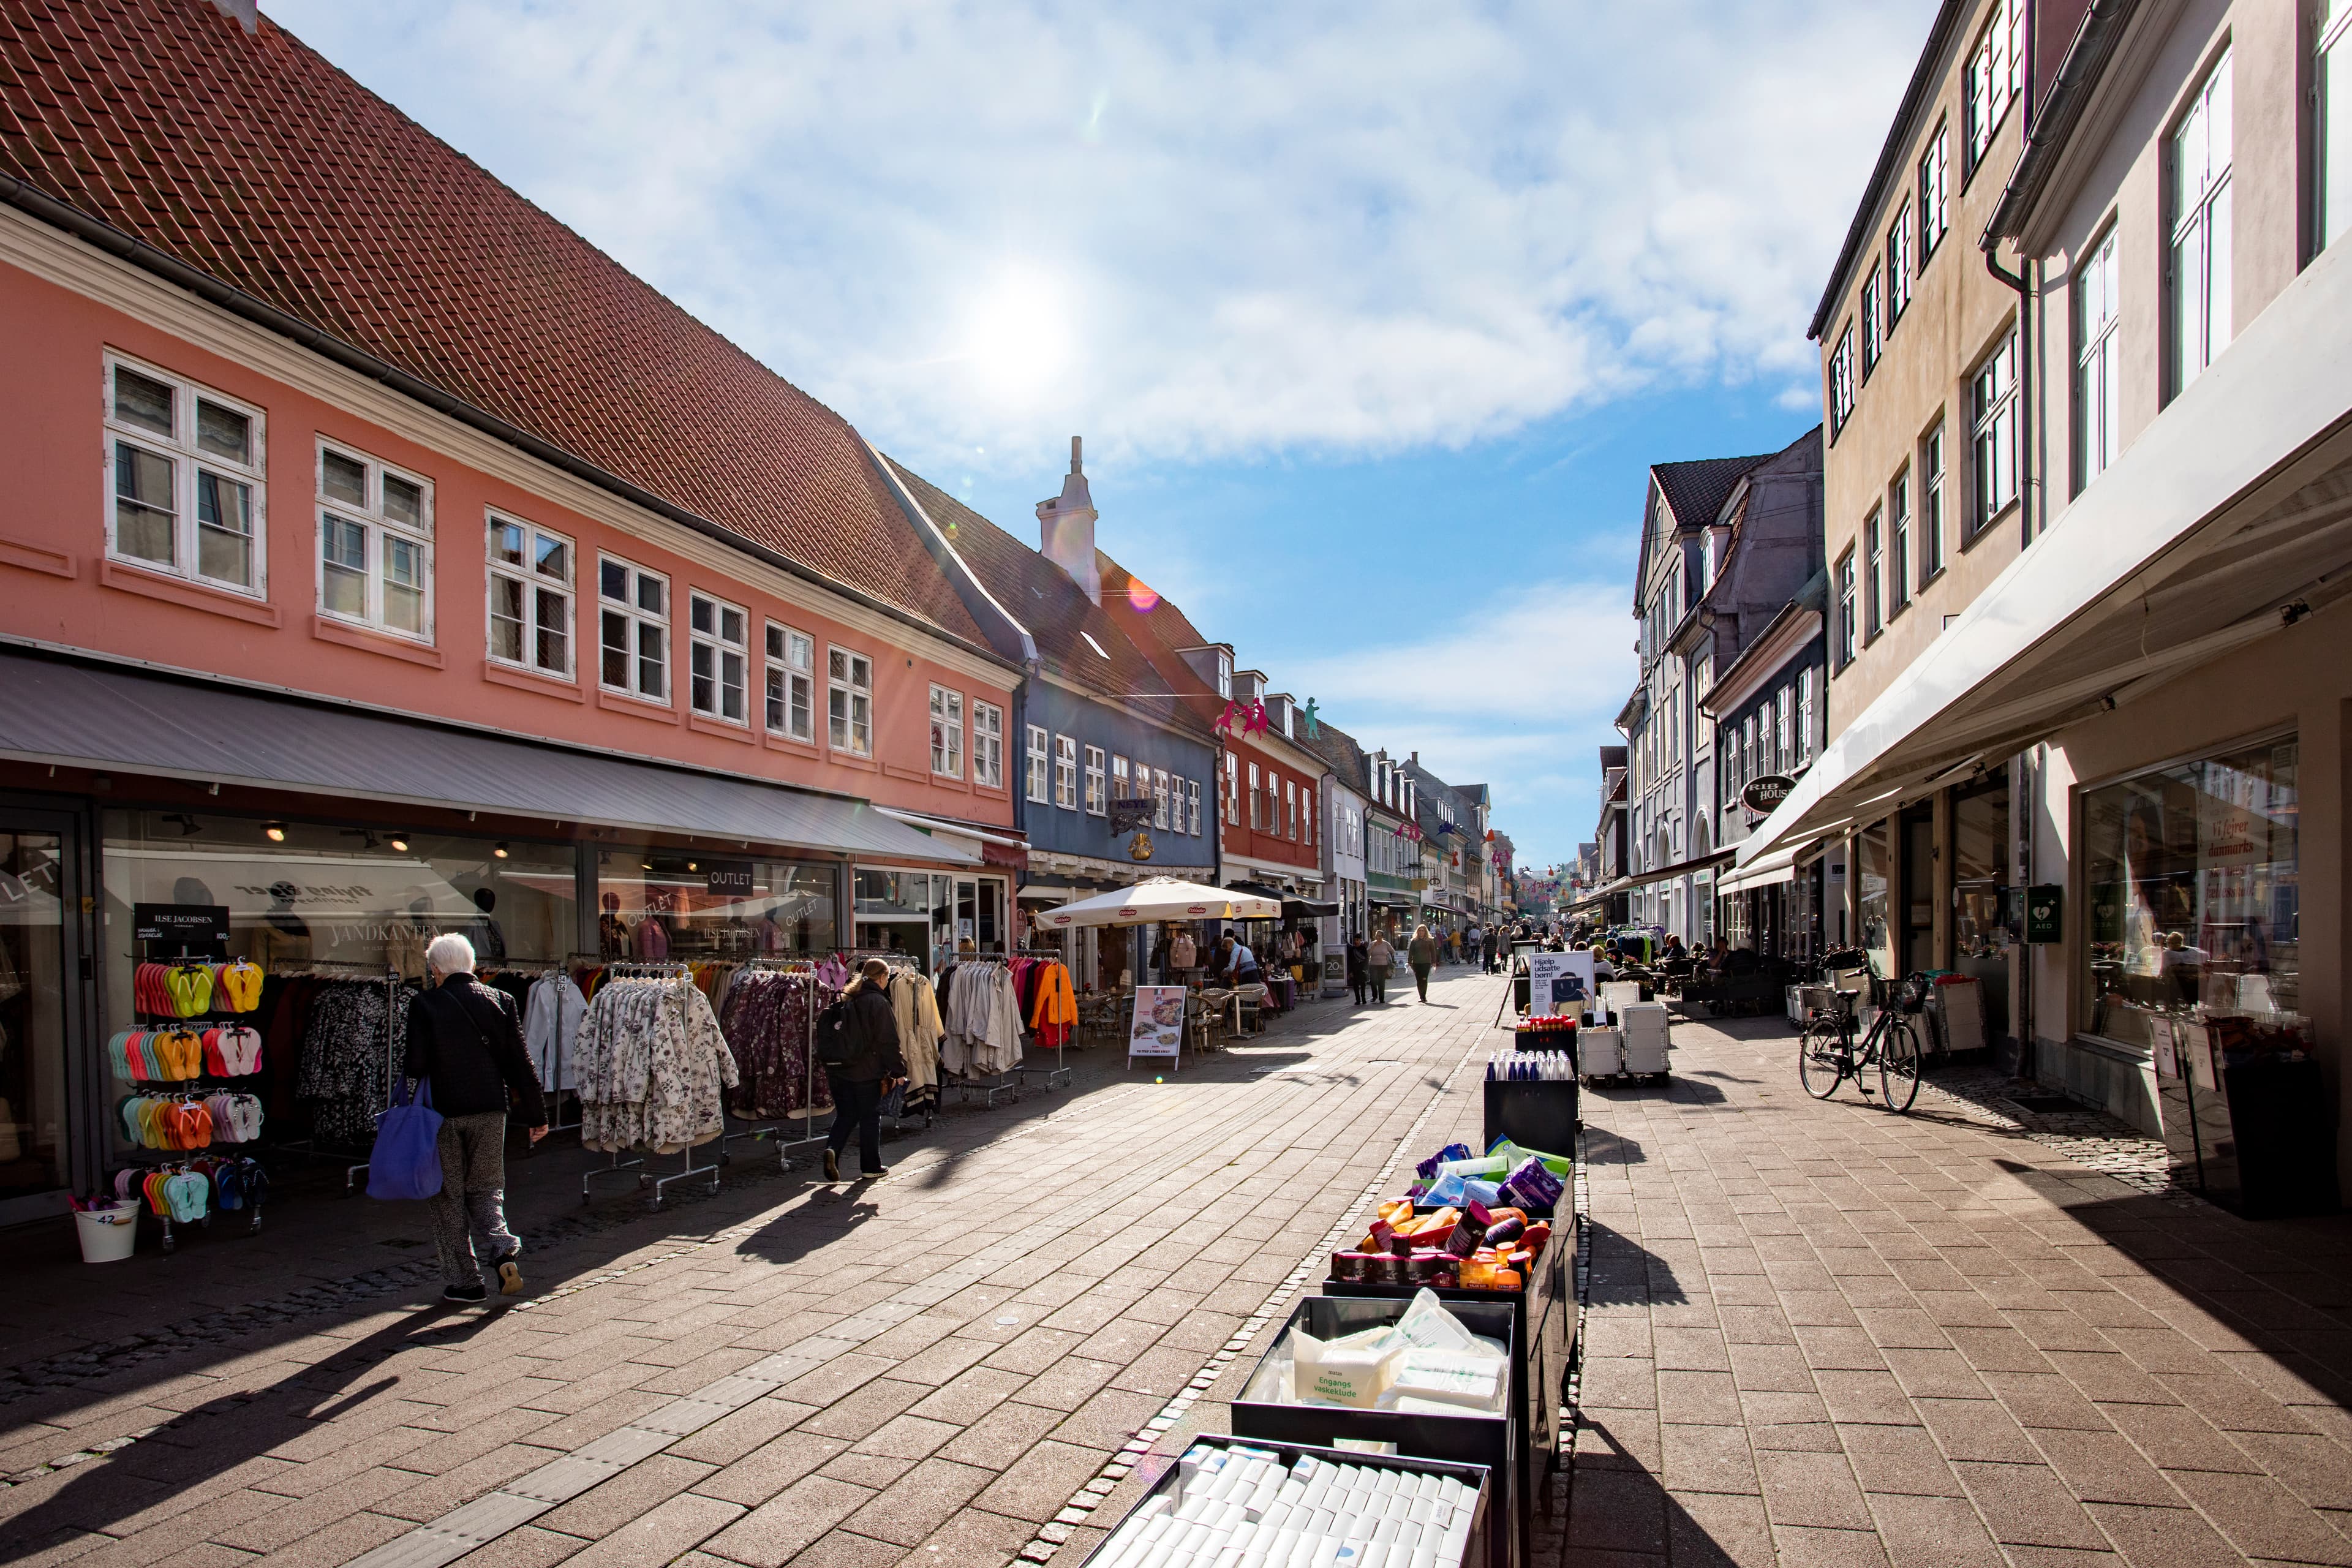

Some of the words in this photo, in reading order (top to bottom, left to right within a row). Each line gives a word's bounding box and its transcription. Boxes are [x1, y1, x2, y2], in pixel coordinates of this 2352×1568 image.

[1118, 800, 1148, 809] NEYE
[2209, 838, 2254, 858] danmarks
[710, 872, 751, 886] OUTLET
[628, 892, 672, 927] OUTLET
[786, 899, 818, 927] OUTLET
[173, 915, 213, 924] JACOBSEN
[331, 925, 442, 947] VANDKANTEN
[704, 927, 722, 939] ILSE
[722, 927, 760, 939] JACOBSEN
[98, 1215, 115, 1224] 42
[1319, 1376, 1352, 1389] Engangs
[1314, 1385, 1357, 1398] vaskeklude
